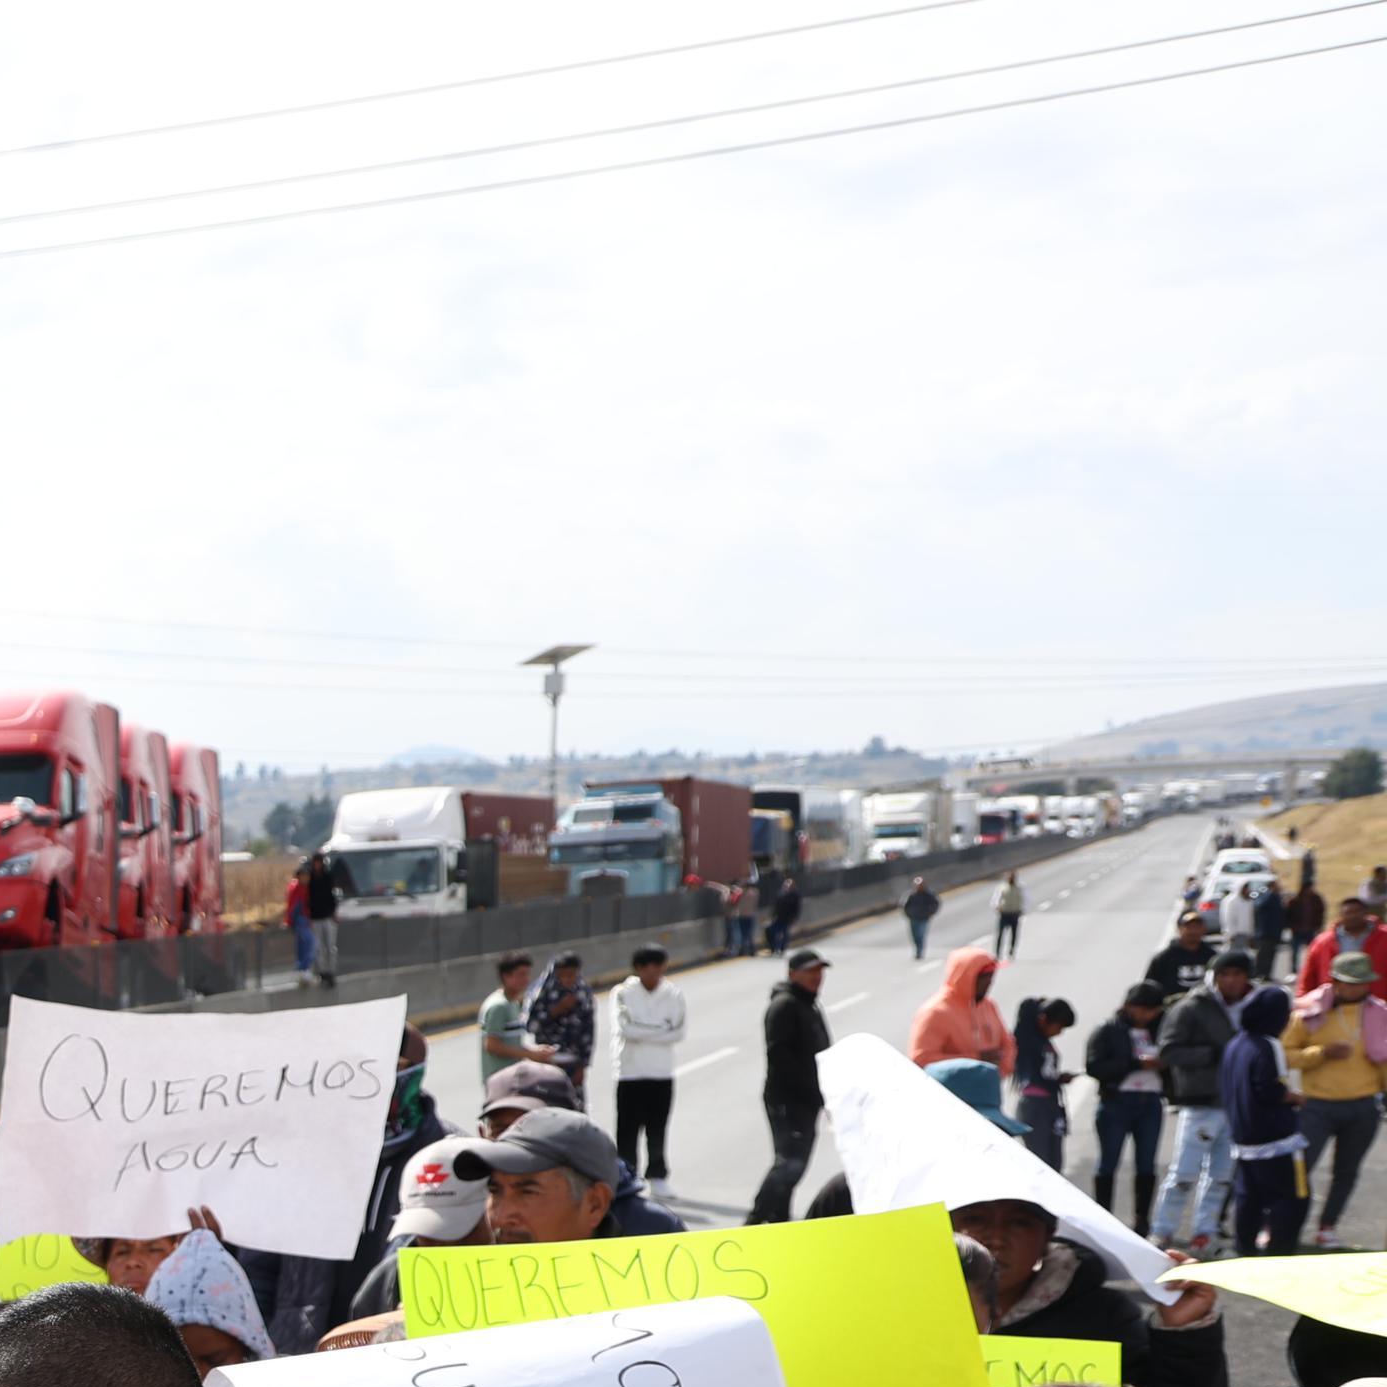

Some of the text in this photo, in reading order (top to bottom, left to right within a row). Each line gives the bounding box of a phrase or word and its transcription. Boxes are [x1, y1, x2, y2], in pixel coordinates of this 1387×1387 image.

[38, 1032, 383, 1124] QUEREMOS
[113, 1134, 280, 1193] AGUA
[411, 1239, 769, 1331] QUEREMOS
